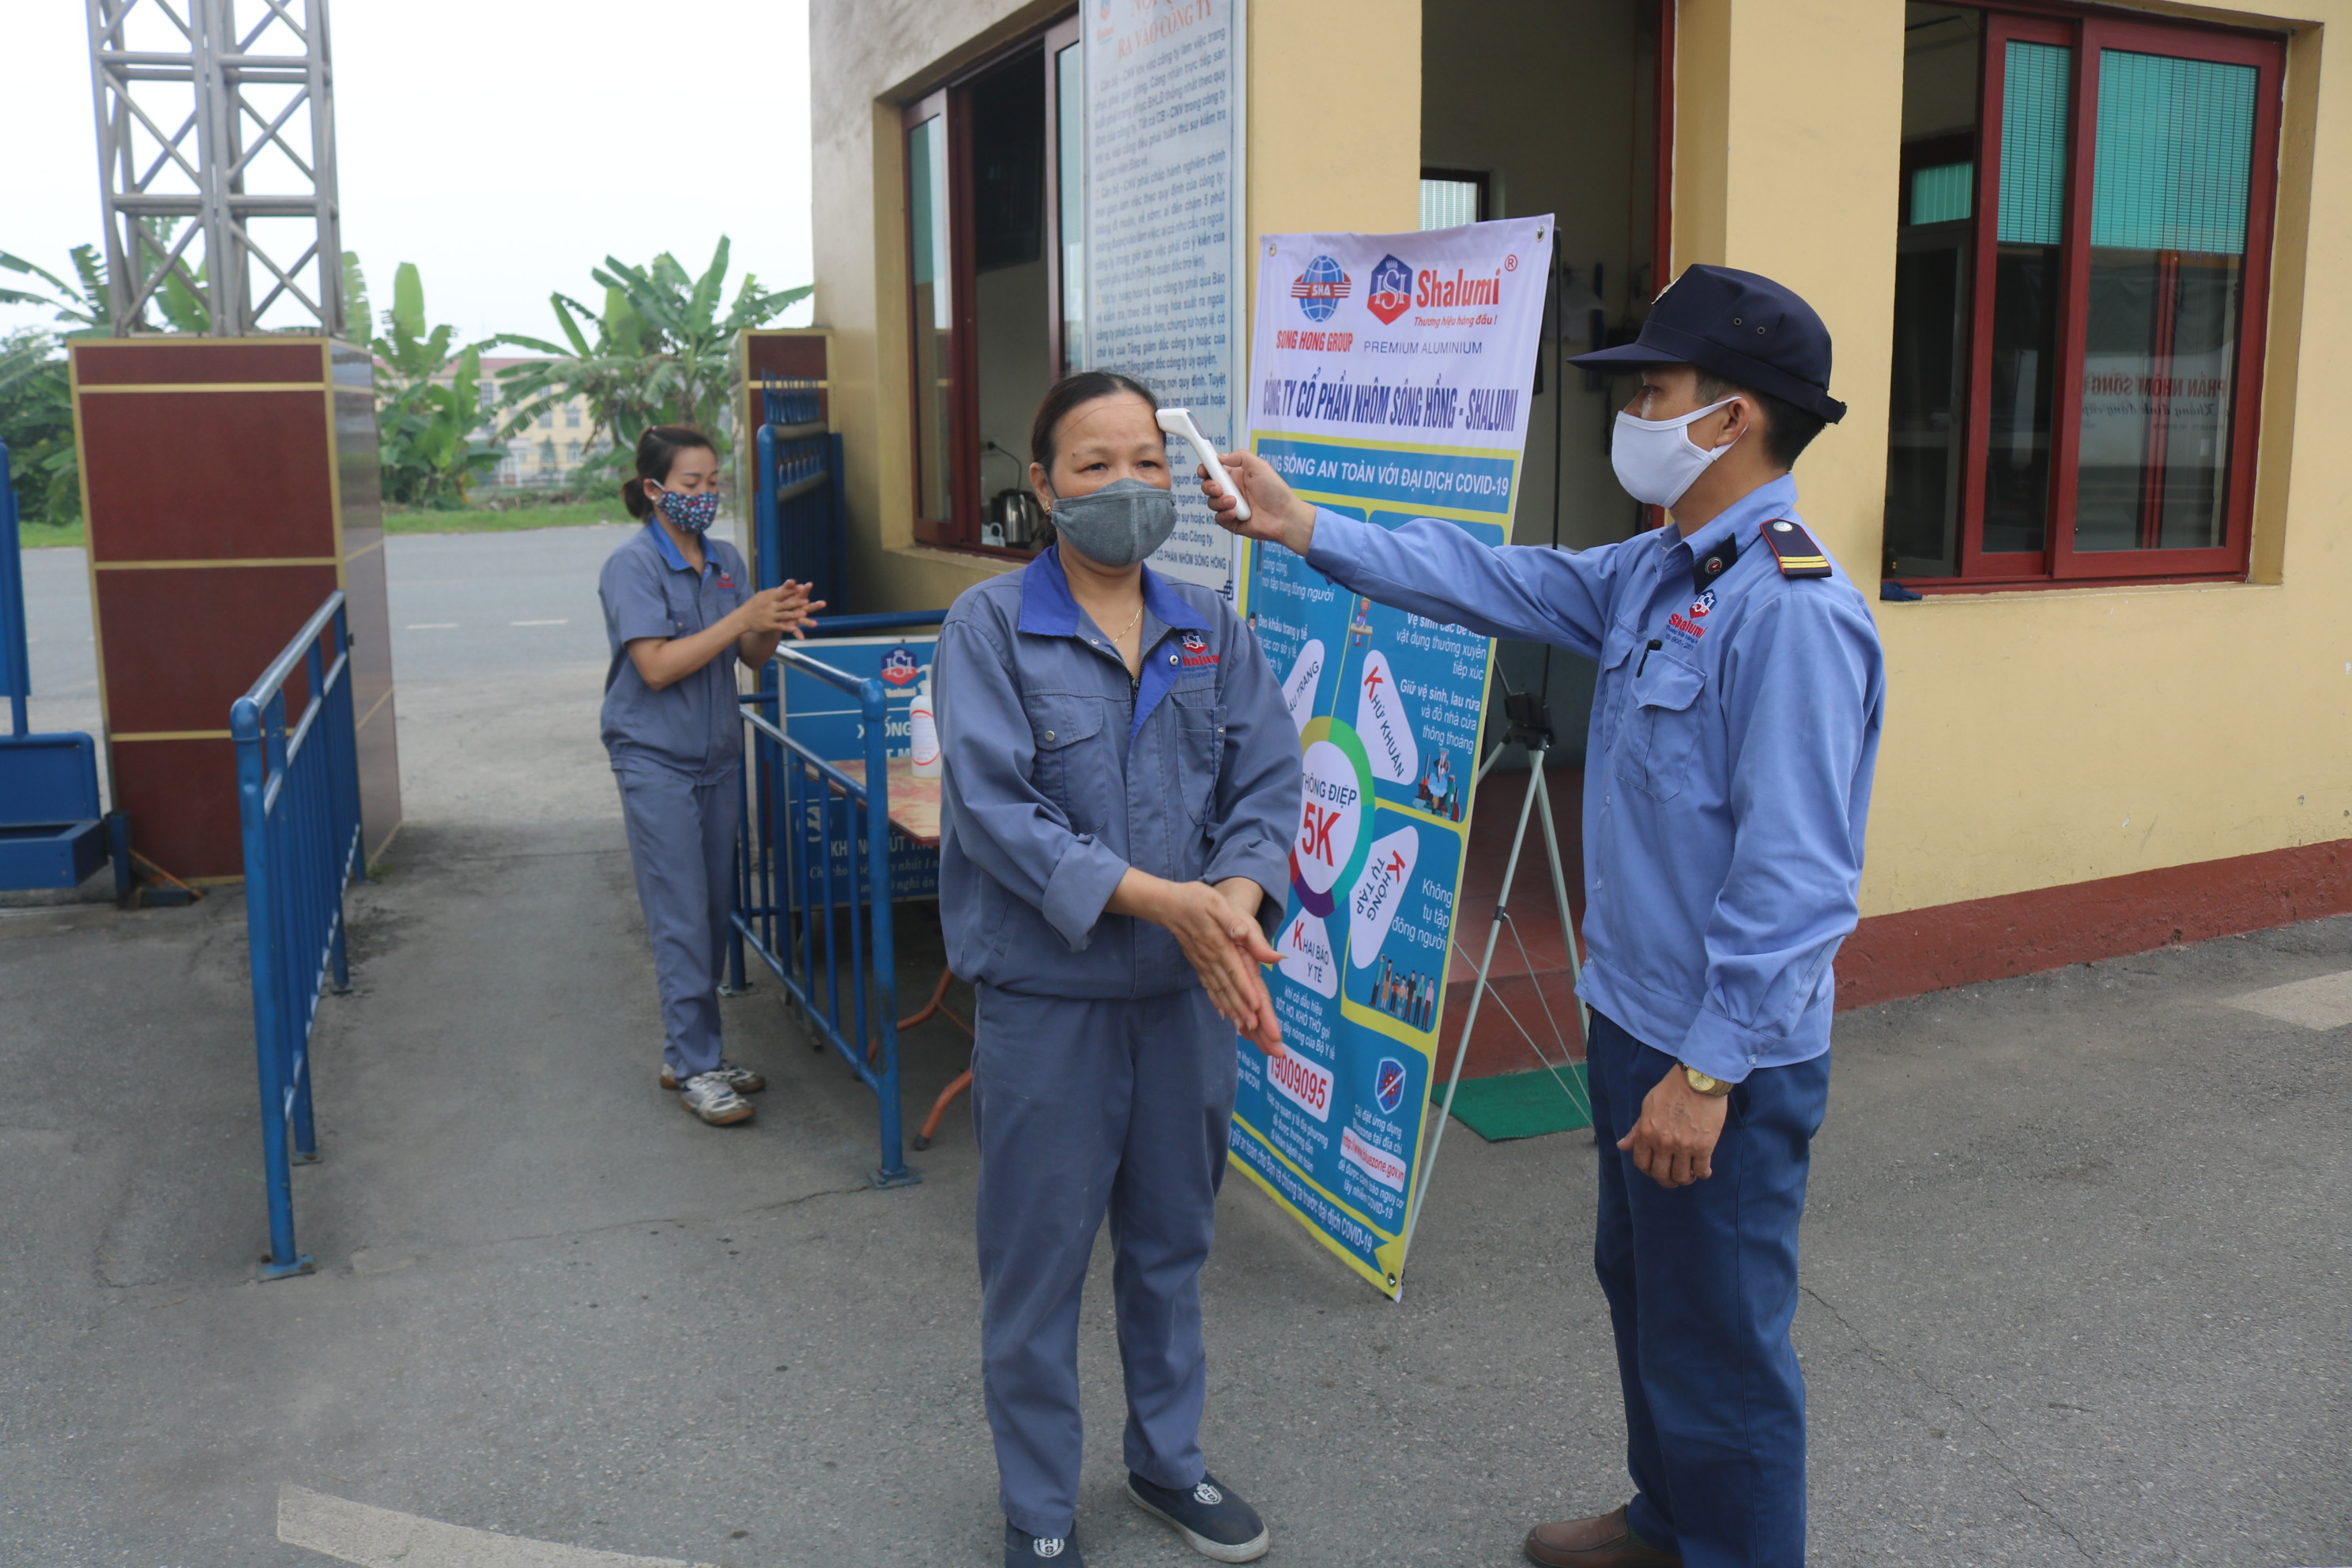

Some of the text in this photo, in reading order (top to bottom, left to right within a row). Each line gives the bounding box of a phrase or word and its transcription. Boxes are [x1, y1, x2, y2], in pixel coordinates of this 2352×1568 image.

[1311, 284, 1331, 296] SHA
[1416, 268, 1501, 307] Shalumi
[1414, 313, 1492, 329] Thương hiệu hàng đầu
[1276, 330, 1353, 352] SONG HONG GROUP
[1363, 341, 1483, 355] PREMIUM ALUMINIUM
[1263, 366, 1519, 432] CÔNG TY CỔ PHẦN NHÔM SÔNG HỒNG SHALUMI
[1283, 452, 1510, 497] SỐNG AN TOÀN VỚI ĐẠI DỊCH COVID-19
[1291, 582, 1306, 601] đông
[1307, 587, 1336, 603] người
[1268, 616, 1283, 633] khẩu
[1283, 623, 1296, 639] trang
[1301, 624, 1308, 641] tế
[1396, 630, 1487, 662] vật dụng thường xuyên
[1297, 662, 1321, 699] TRANG
[1453, 658, 1484, 681] tiếp xúc
[1400, 678, 1480, 711] Giữ vệ sinh, lau rửa
[1421, 703, 1476, 731] và đồ nhà cửa
[1422, 725, 1475, 755] thông thoáng
[1302, 772, 1358, 809] THÔNG ĐIỆP
[1302, 801, 1341, 868] 5K
[1371, 857, 1385, 880] TỤ
[1367, 849, 1406, 922] KHÔNG
[1422, 877, 1453, 909] Không
[1423, 904, 1449, 931] tụ tập
[1292, 919, 1329, 966] KHAI BÁO
[1392, 916, 1447, 952] đông người
[1307, 962, 1314, 978] Y
[1310, 999, 1323, 1016] hiệu
[1295, 1010, 1308, 1027] KHÓ
[1321, 1025, 1331, 1040] gọi
[1291, 1027, 1305, 1046] nóng
[1305, 1035, 1315, 1050] của
[1315, 1040, 1325, 1057] Bộ
[1325, 1043, 1330, 1056] Y
[1270, 1054, 1327, 1110] 19009095
[1372, 1115, 1385, 1132] ứng
[1386, 1121, 1402, 1140] dụng
[1373, 1132, 1381, 1147] tại
[1382, 1136, 1393, 1152] địa
[1367, 1195, 1393, 1220] COVID-19
[1380, 1187, 1396, 1207] nguy
[1396, 1197, 1404, 1208] cơ
[1340, 1218, 1373, 1253] COVID-19
